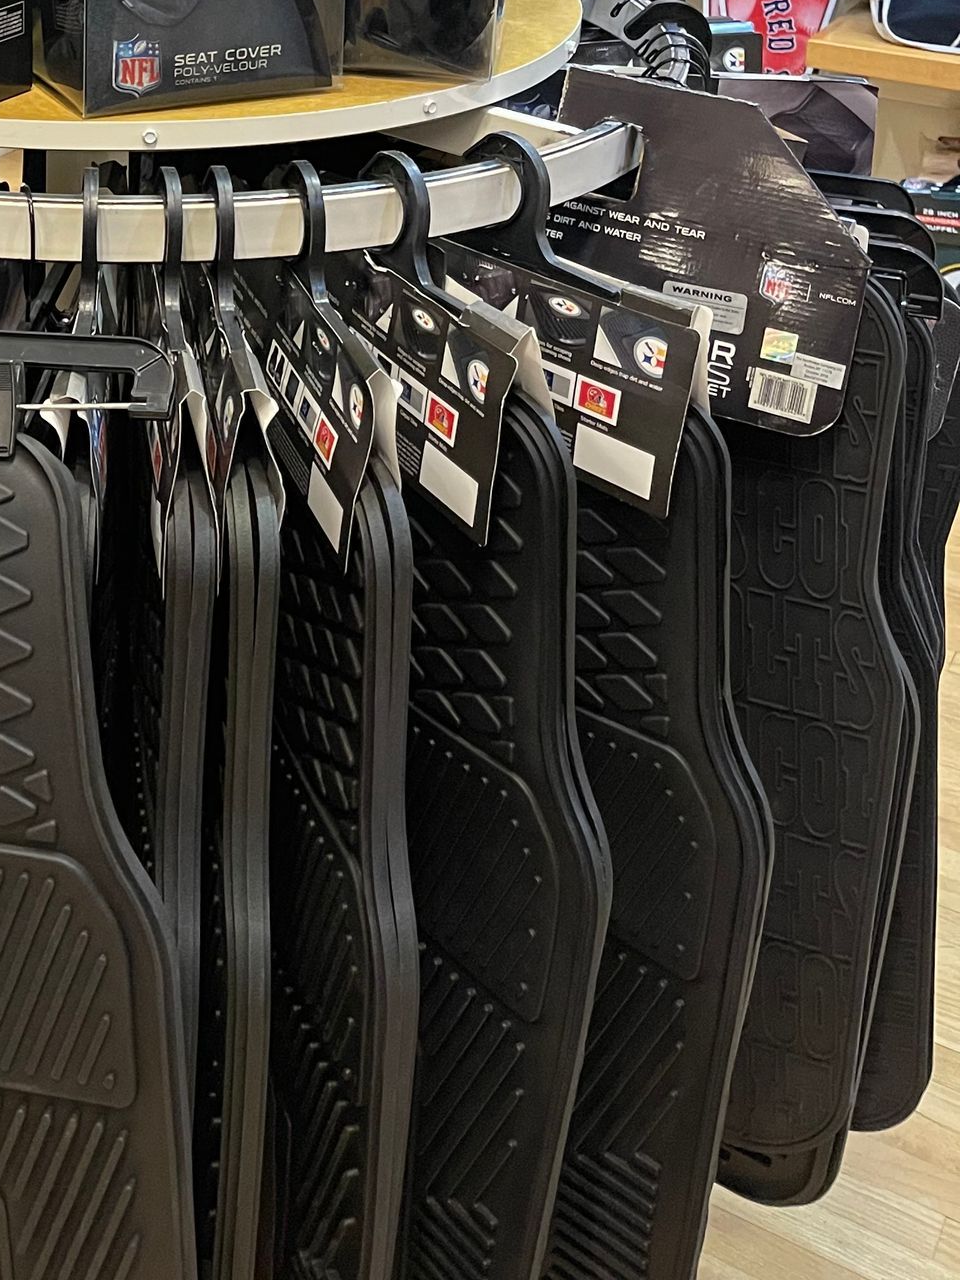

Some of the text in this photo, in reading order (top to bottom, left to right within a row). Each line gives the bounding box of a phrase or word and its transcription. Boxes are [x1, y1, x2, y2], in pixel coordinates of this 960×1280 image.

[173, 43, 283, 67] SEAT COVER
[119, 56, 161, 87] NFL
[173, 58, 268, 79] POLY-VELOUR
[174, 76, 212, 86] CONTAINS
[552, 213, 643, 243] DIRT AND WATER
[563, 200, 707, 241] AGAINST WEAR AND TEAR
[671, 284, 733, 304] WARNING
